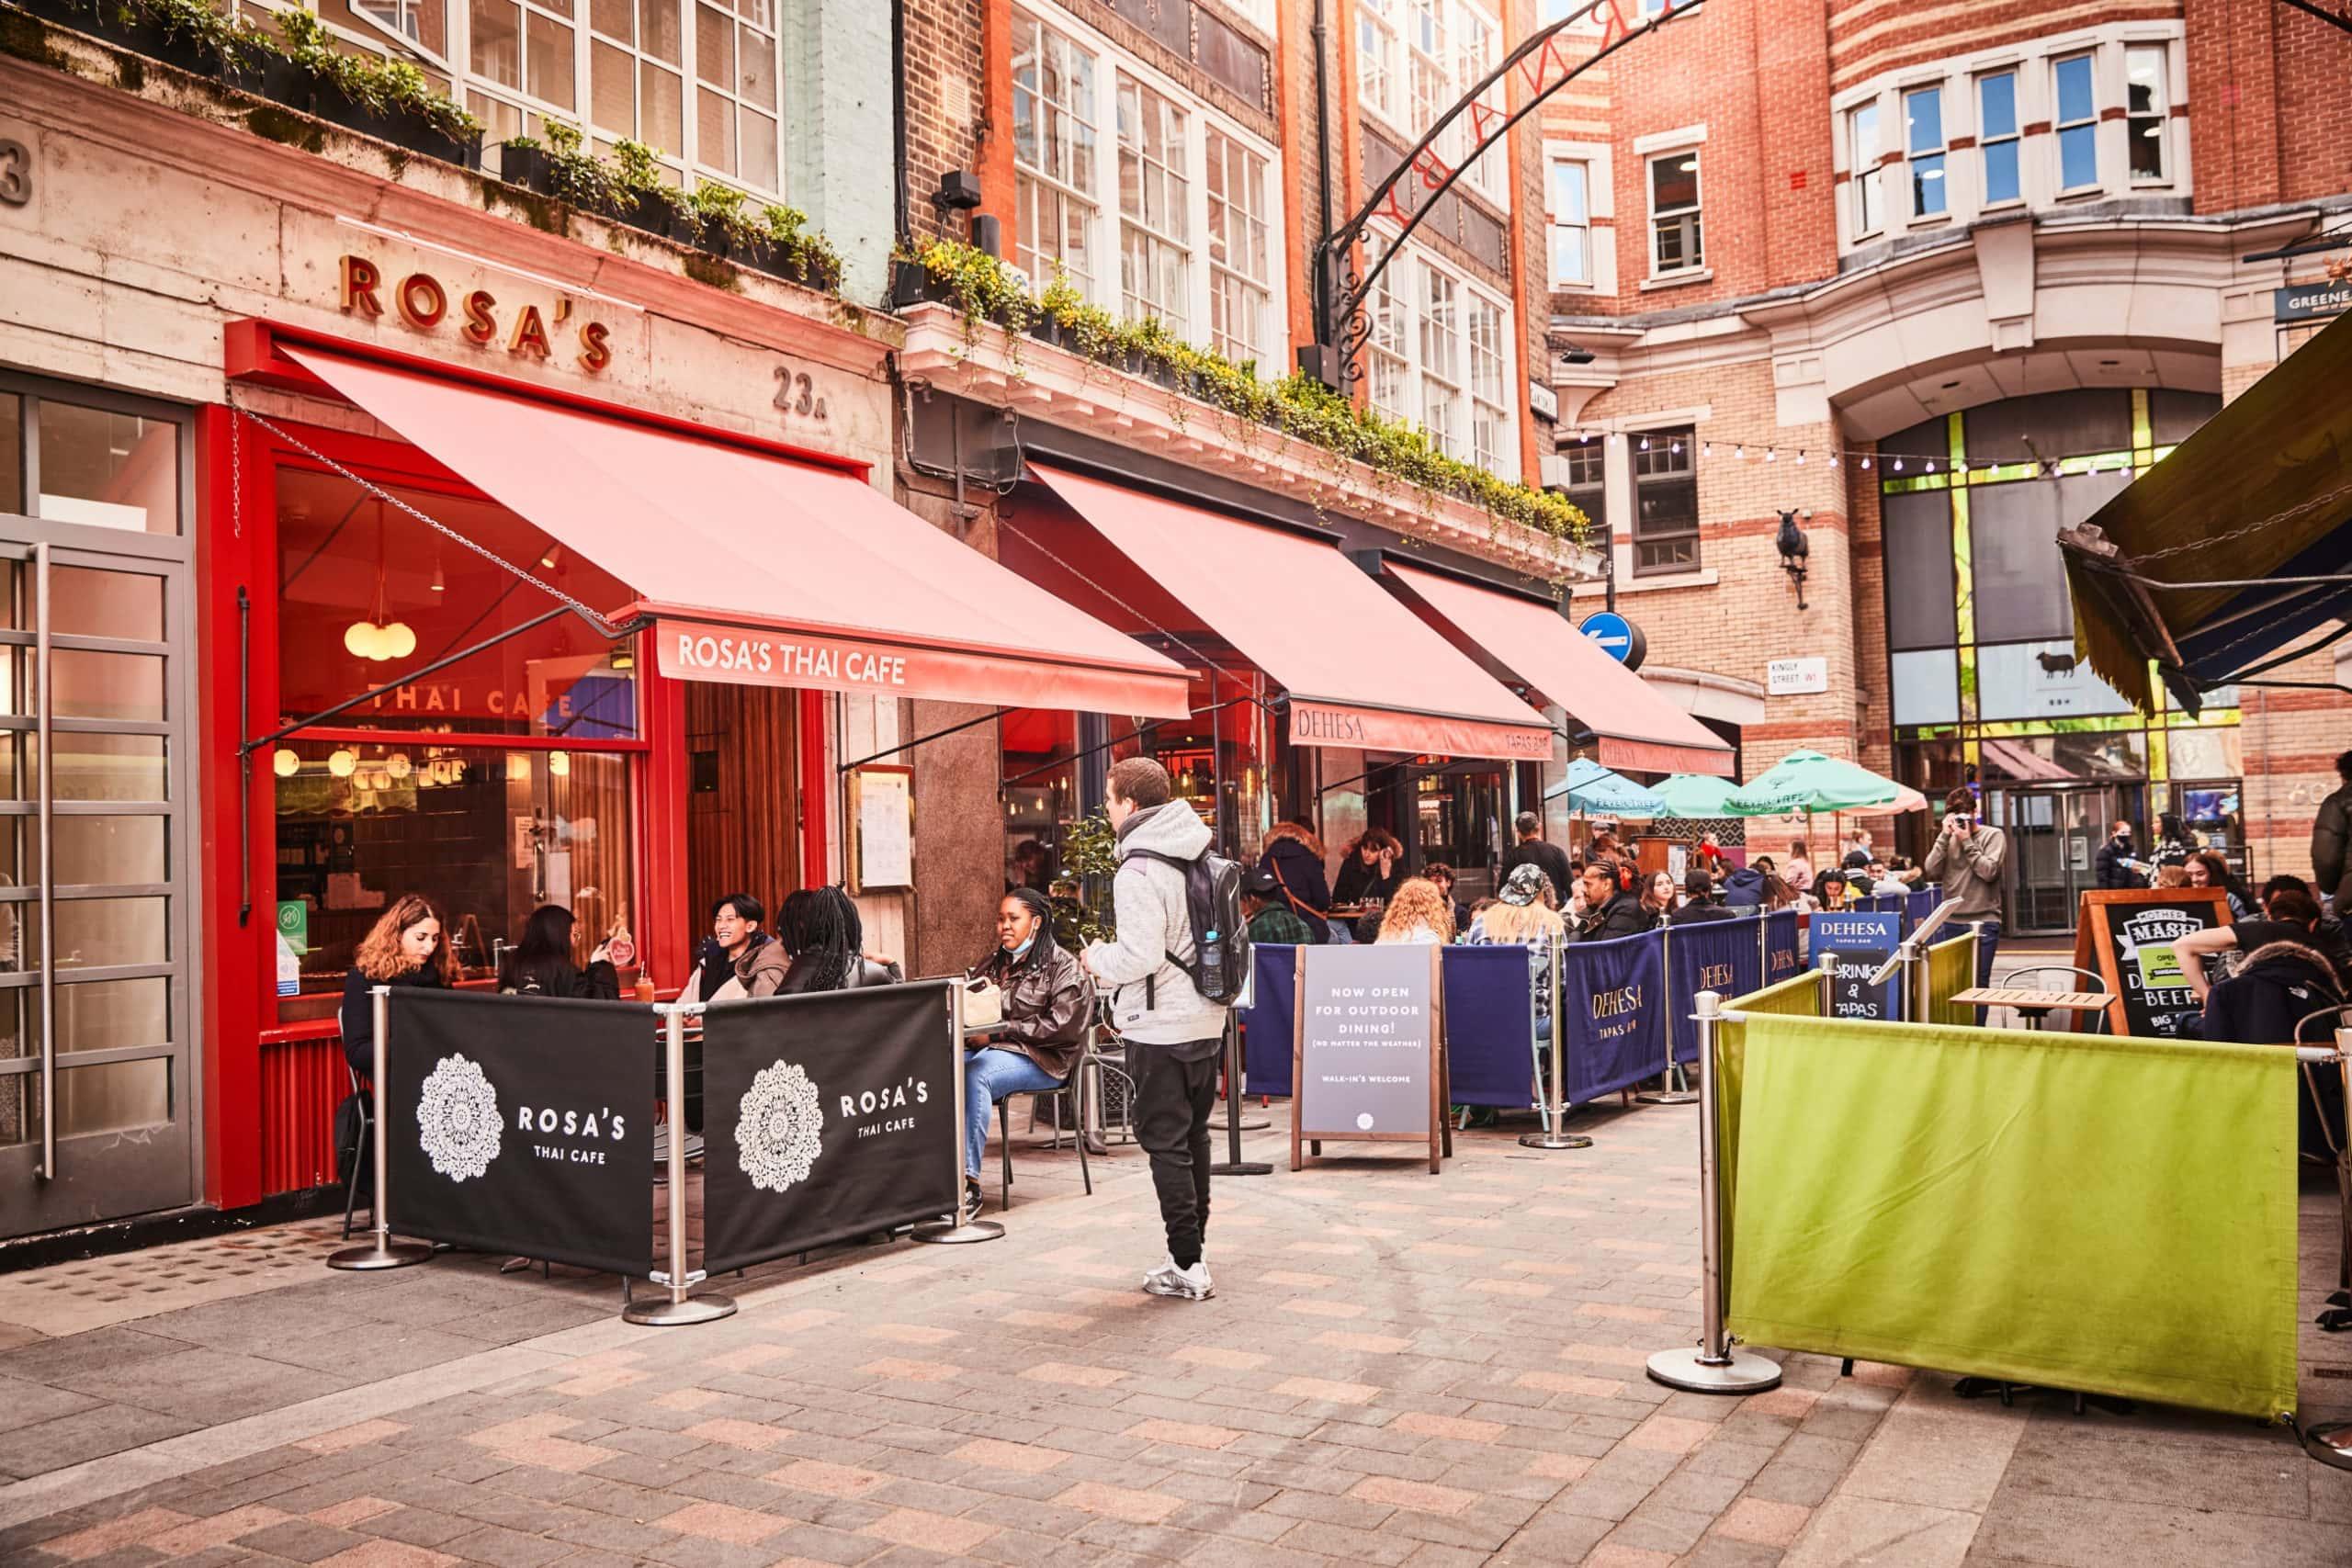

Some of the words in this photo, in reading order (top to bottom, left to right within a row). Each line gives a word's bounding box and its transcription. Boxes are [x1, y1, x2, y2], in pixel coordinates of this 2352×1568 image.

[2289, 289, 2350, 310] GREENE
[339, 254, 612, 375] ROSA'S
[678, 634, 772, 673] ROSA'S
[779, 645, 838, 677] THAI
[844, 652, 906, 684] CAFE
[1772, 673, 1799, 684] STREET
[368, 682, 460, 712] THAI
[487, 689, 573, 718] CAE
[1297, 708, 1364, 741] DEHESA
[1820, 922, 1887, 936] DEHESA
[2132, 921, 2198, 942] MASH
[1331, 987, 1365, 998] NOW
[1372, 987, 1409, 998] OPEN
[1848, 983, 1859, 998] &
[1316, 1006, 1341, 1016] FOR
[1348, 1006, 1419, 1016] OUTDOOR
[1593, 985, 1643, 1020] DEHESA
[1339, 1021, 1396, 1034] DINING!
[2151, 1014, 2172, 1027] BIG
[840, 1077, 929, 1118] ROSA'S
[518, 1106, 626, 1141] ROSA'S
[858, 1123, 881, 1138] THAI
[885, 1117, 915, 1133] CAFE
[534, 1145, 565, 1160] THAI
[571, 1149, 605, 1165] CAFE
